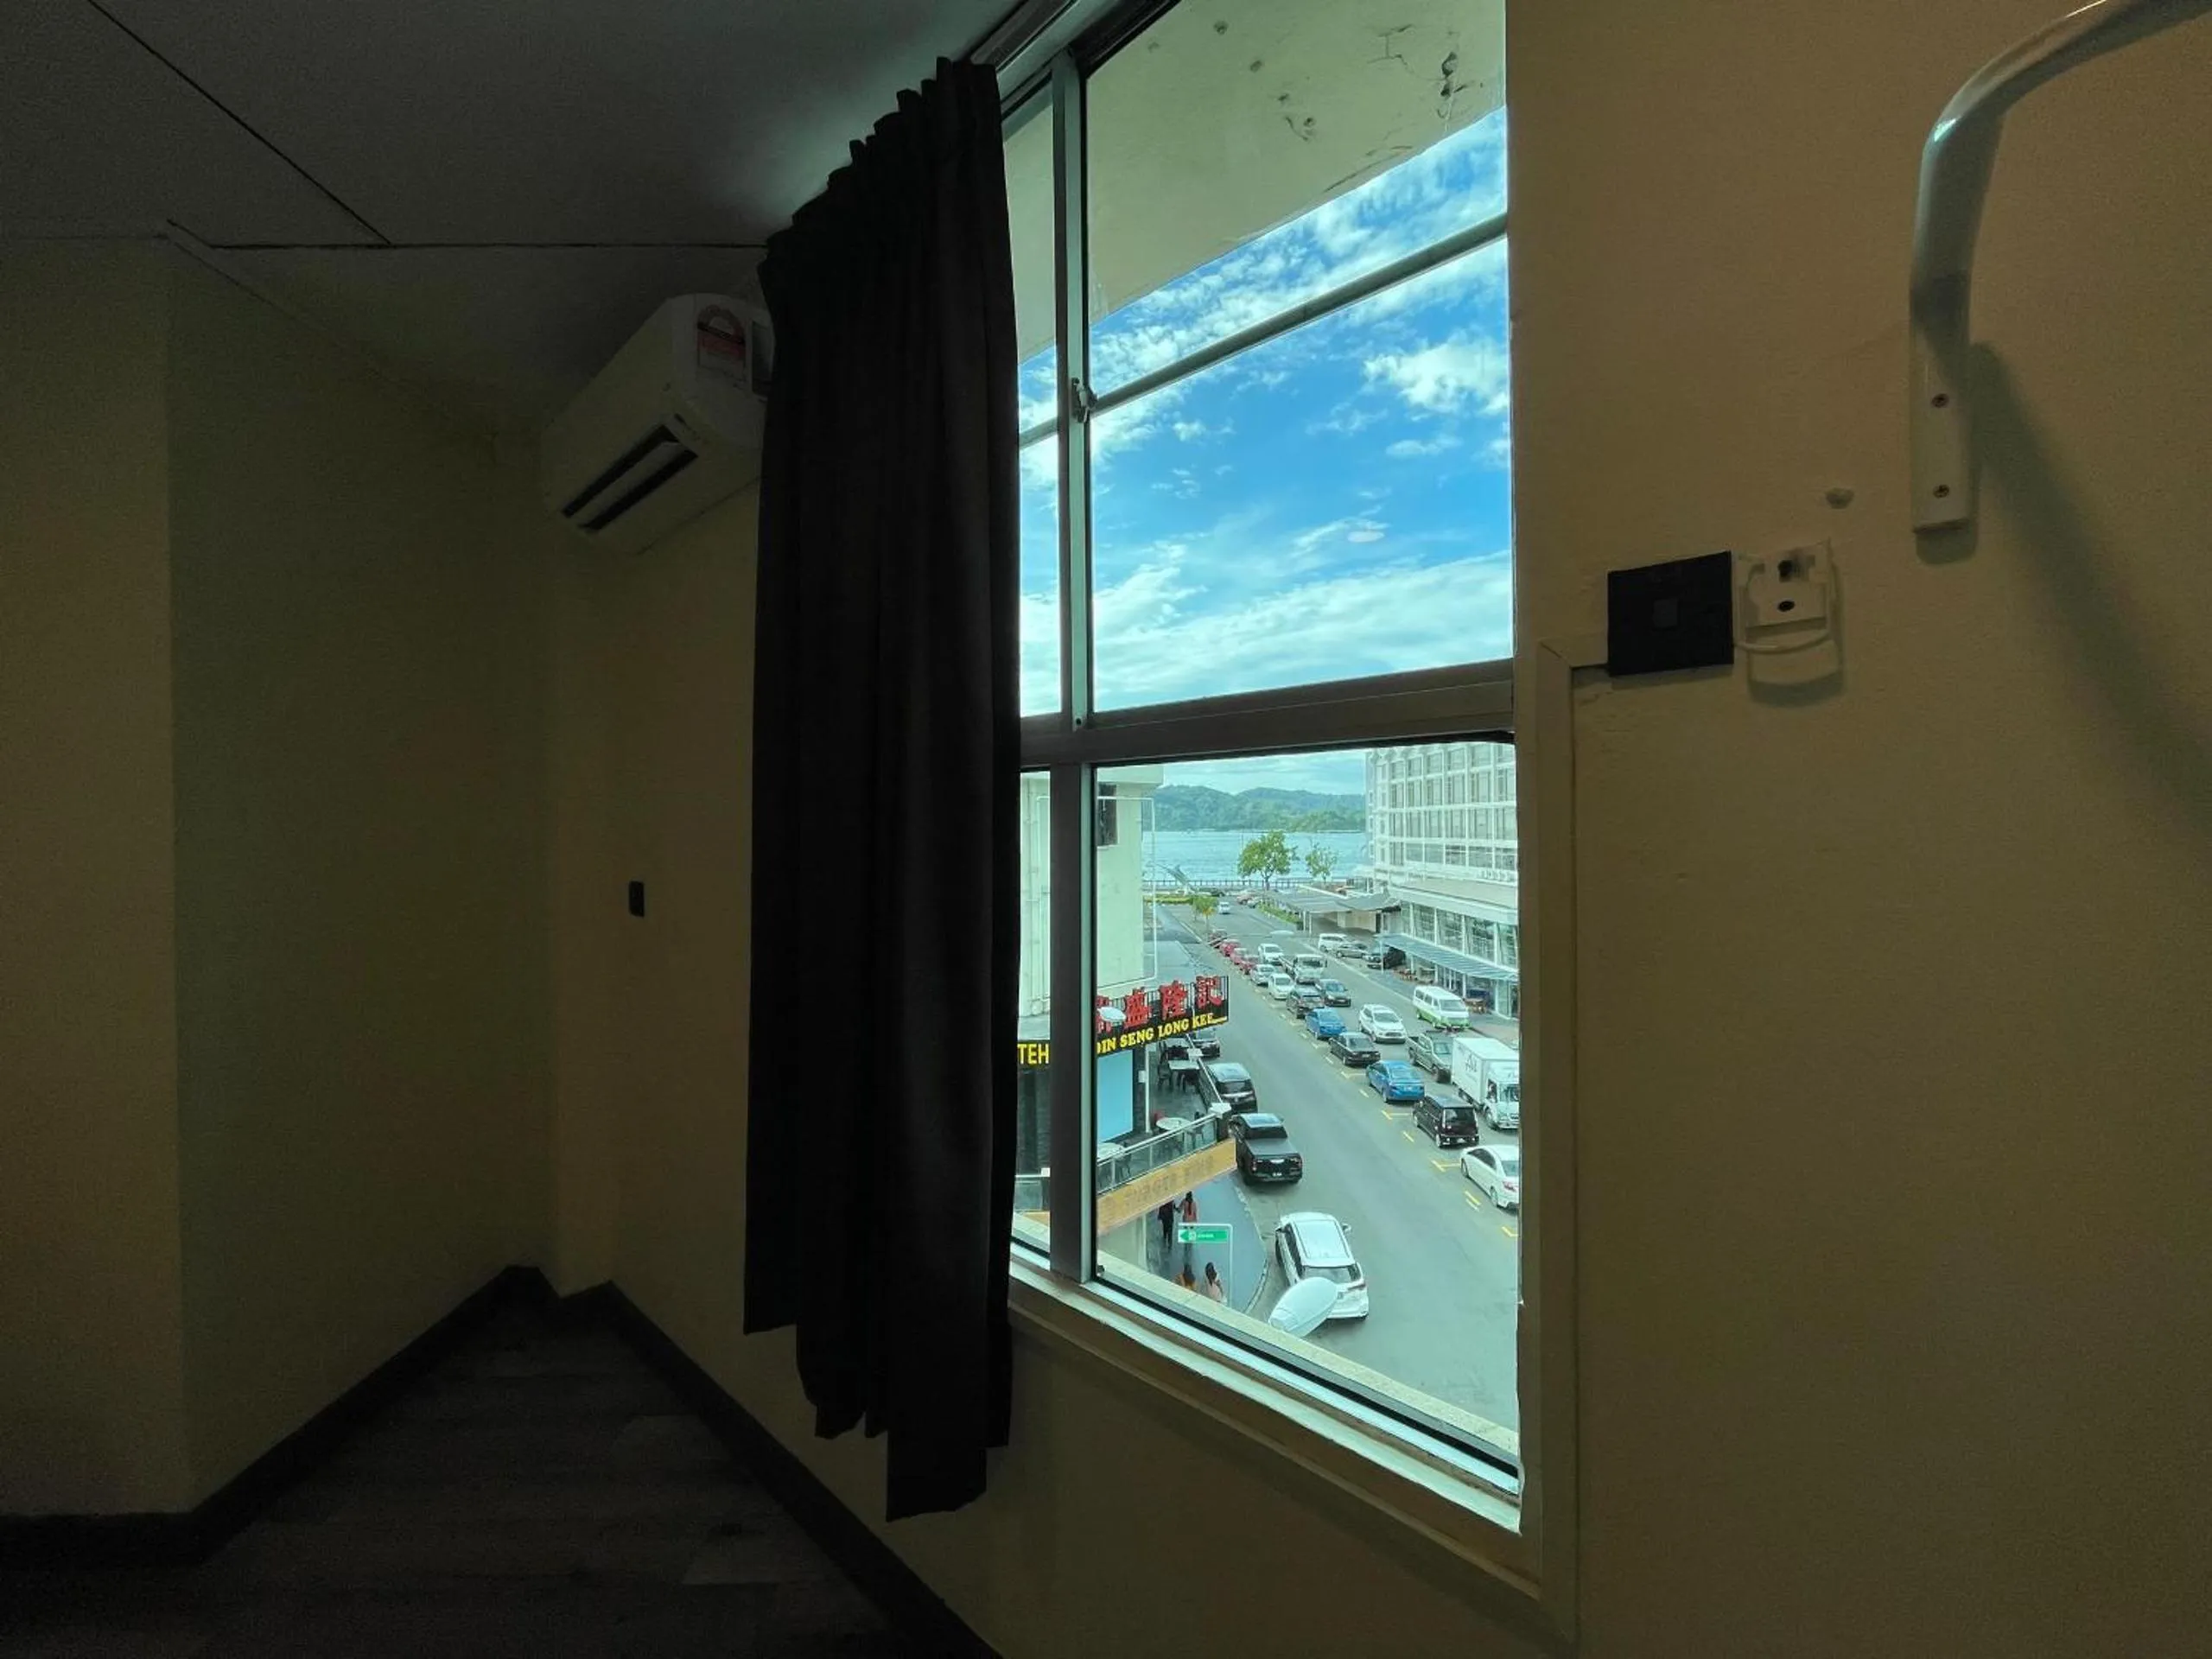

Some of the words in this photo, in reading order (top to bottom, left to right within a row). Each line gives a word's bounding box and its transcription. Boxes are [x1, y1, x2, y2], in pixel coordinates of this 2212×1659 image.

[1120, 1027, 1154, 1048] SENG
[1157, 1019, 1190, 1038] LONG
[1192, 1013, 1215, 1029] KEE
[1017, 1043, 1050, 1065] TEH
